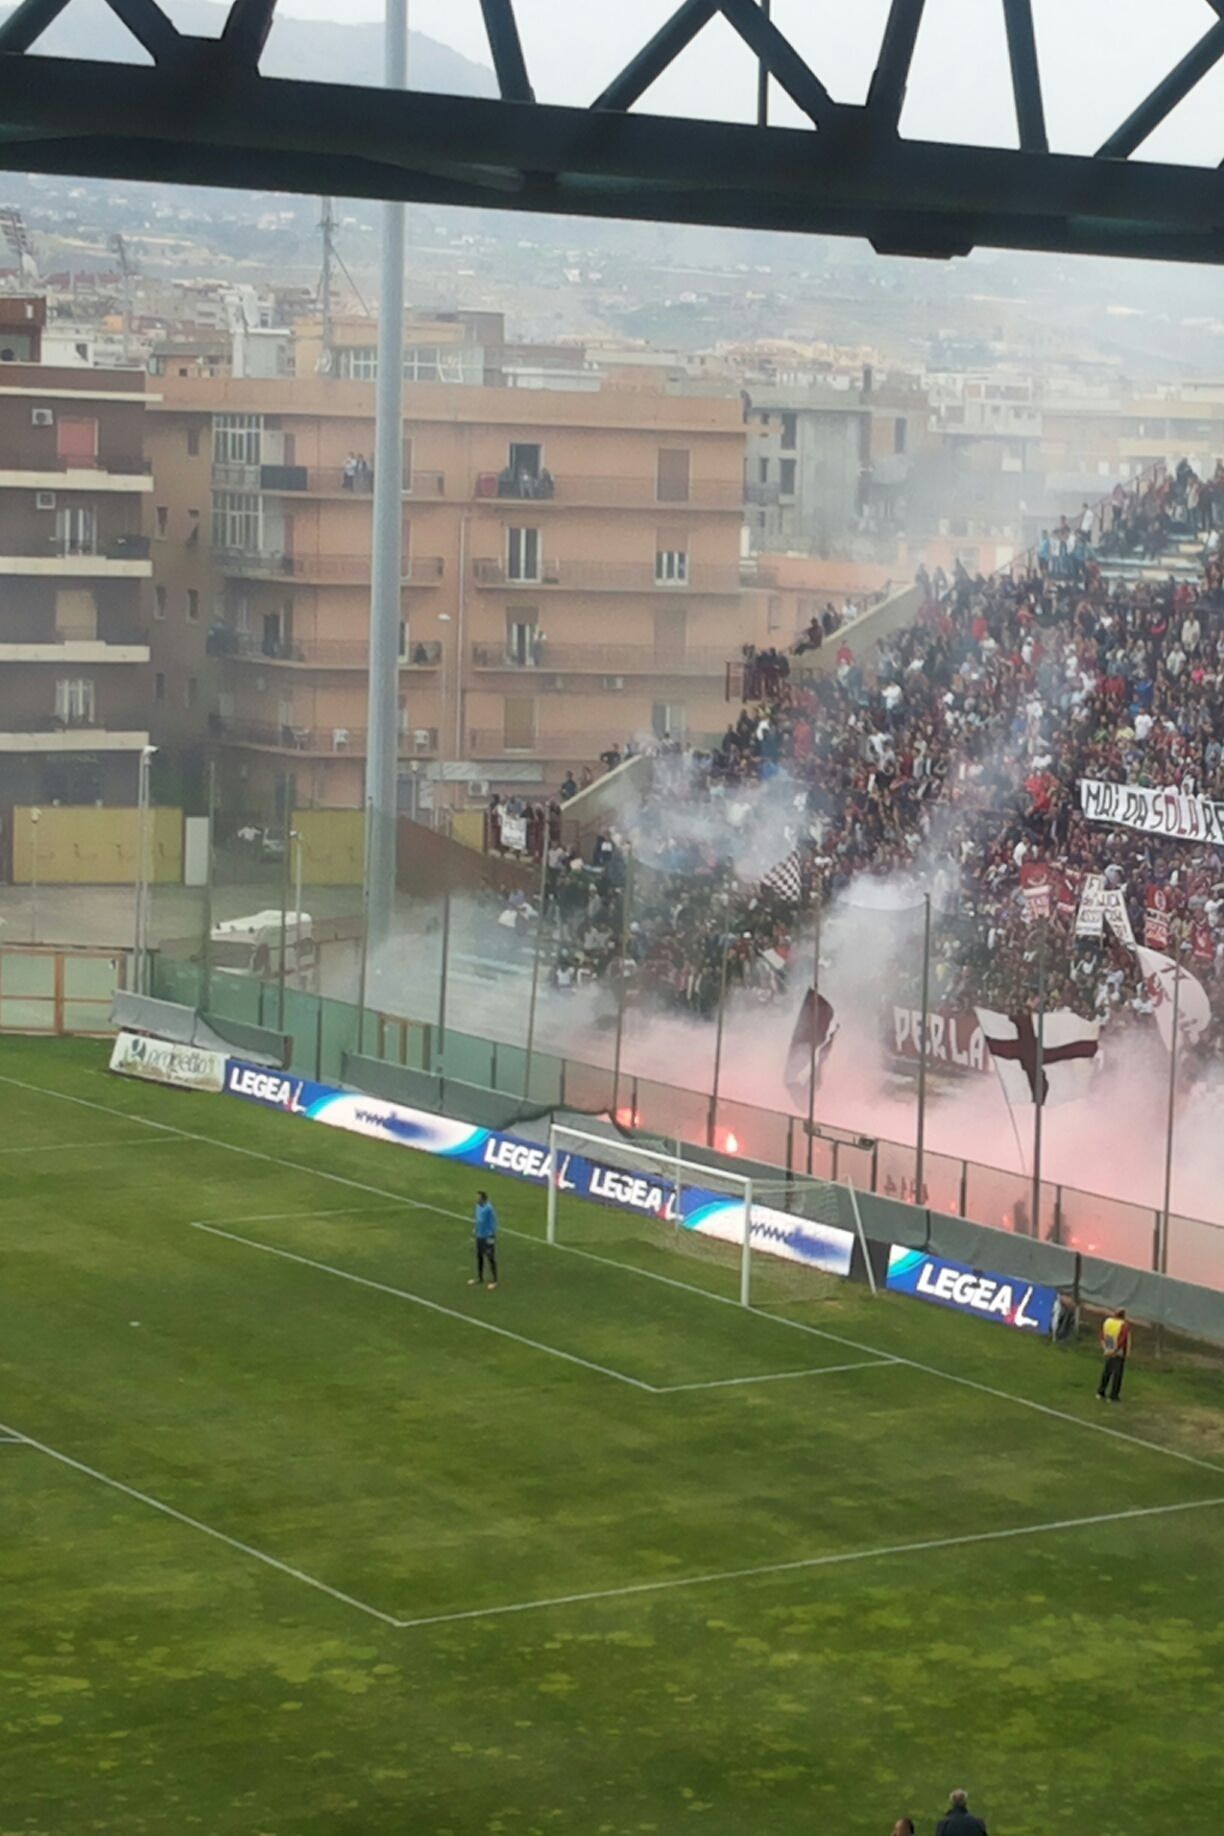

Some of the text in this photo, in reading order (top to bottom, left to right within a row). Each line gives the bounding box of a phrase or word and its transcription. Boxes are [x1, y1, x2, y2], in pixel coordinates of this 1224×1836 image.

[1122, 791, 1148, 828] DA
[1149, 793, 1200, 838] SOLA
[229, 1066, 293, 1108] LEGEA
[484, 1138, 553, 1179] LEGEA
[589, 1167, 664, 1210] LEGEA
[916, 1262, 1014, 1316] LEGEA
